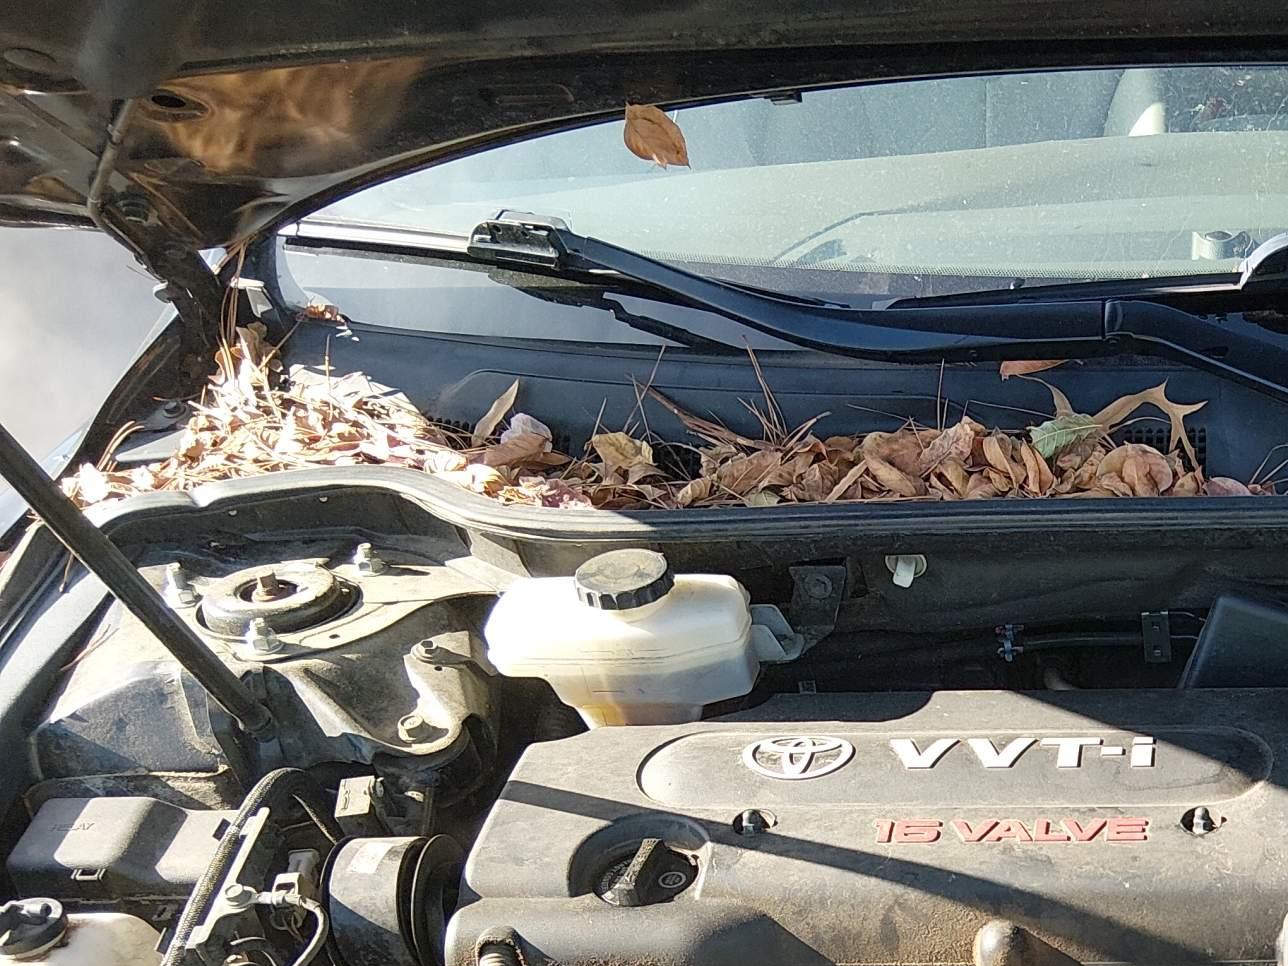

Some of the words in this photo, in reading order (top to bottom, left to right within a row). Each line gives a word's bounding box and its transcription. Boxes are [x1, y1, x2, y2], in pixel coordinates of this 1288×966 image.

[890, 737, 1157, 770] VVT-i
[875, 817, 943, 844] 16
[950, 817, 1150, 844] VALVE
